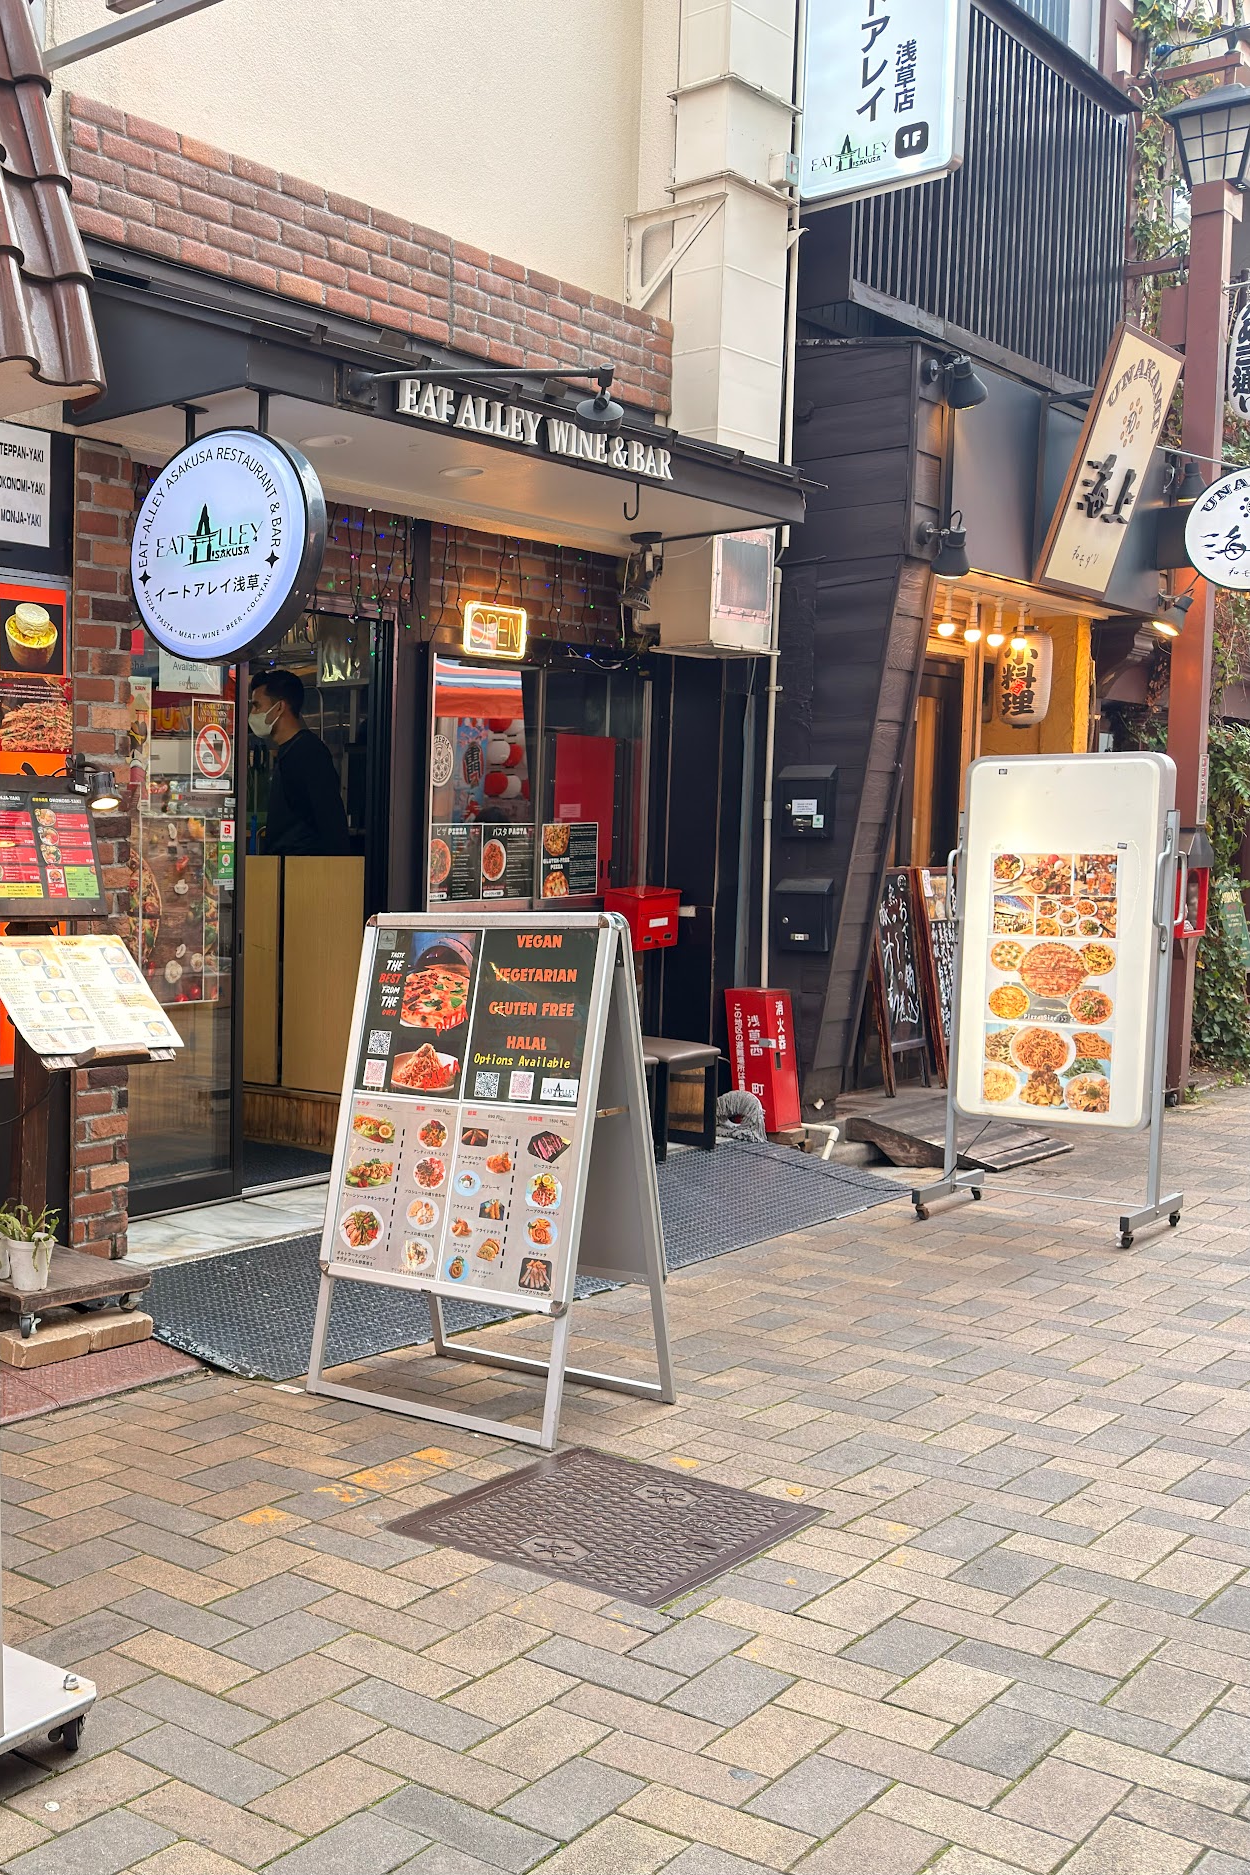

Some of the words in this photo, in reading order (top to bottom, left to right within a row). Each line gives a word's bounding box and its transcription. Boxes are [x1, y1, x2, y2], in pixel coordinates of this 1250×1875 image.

[893, 39, 917, 114] 浅草店
[902, 130, 922, 149] 1F
[1106, 359, 1166, 435] UNAKAMI
[0, 441, 45, 464] TEPPAN-YAKI
[546, 418, 607, 464] WINE
[608, 436, 628, 470] &
[627, 439, 674, 481] BAR
[166, 448, 213, 490] ASAKUSA
[217, 447, 277, 499] RESTAURANT
[269, 502, 281, 514] &
[1200, 478, 1250, 512] UNA
[0, 508, 43, 528] MONJA-YAKI
[138, 487, 166, 568] EAT-ALLEY
[271, 516, 282, 547] BAR
[155, 573, 260, 602] イートアレイ浅草
[143, 590, 155, 612] PIZZA
[157, 614, 173, 632] PASTA
[179, 628, 196, 640] MEAT
[201, 628, 220, 639] WINE
[226, 616, 243, 631] BEER
[247, 573, 273, 612] COCKTAIL
[470, 612, 521, 648] OPEN
[1001, 646, 1039, 717] 小料理
[436, 826, 447, 836] ピザ
[448, 827, 467, 836] PIZZA
[492, 828, 507, 837] パスタ
[508, 827, 528, 836] PASTA
[517, 934, 563, 949] VEGAN
[379, 973, 402, 984] BEST
[386, 960, 405, 971] THE
[495, 968, 578, 983] VEGETARIAN
[381, 985, 401, 995] FROM
[381, 996, 400, 1008] THE
[435, 1005, 468, 1037] PIZZA
[489, 1001, 538, 1016] GLUTEN
[542, 1003, 576, 1017] FREE
[775, 1000, 787, 1050] 消火器
[506, 1036, 547, 1051] HALAL
[474, 1053, 514, 1066] Options
[518, 1054, 571, 1070] Available
[422, 1060, 461, 1092] PASTA
